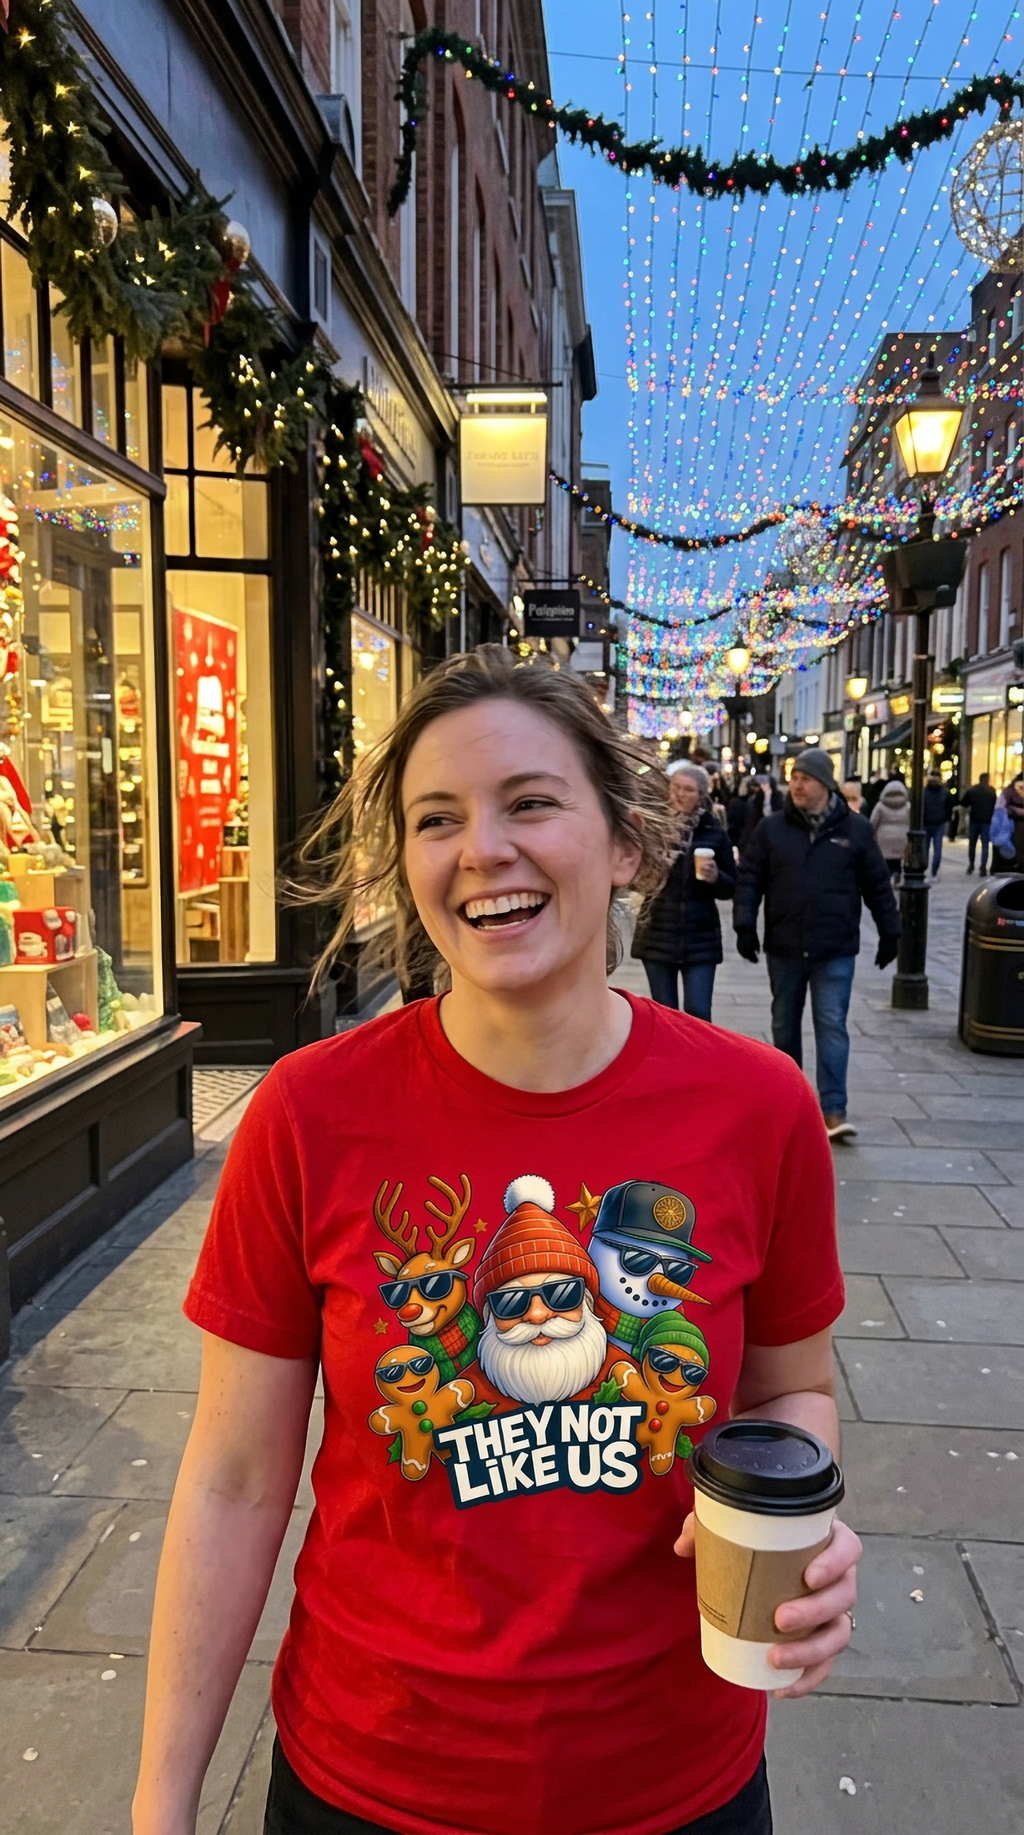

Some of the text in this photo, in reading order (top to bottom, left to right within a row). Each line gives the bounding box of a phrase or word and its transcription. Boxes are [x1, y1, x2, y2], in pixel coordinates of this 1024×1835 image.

[438, 1404, 642, 1463] THEY NOT
[567, 1440, 639, 1489] US
